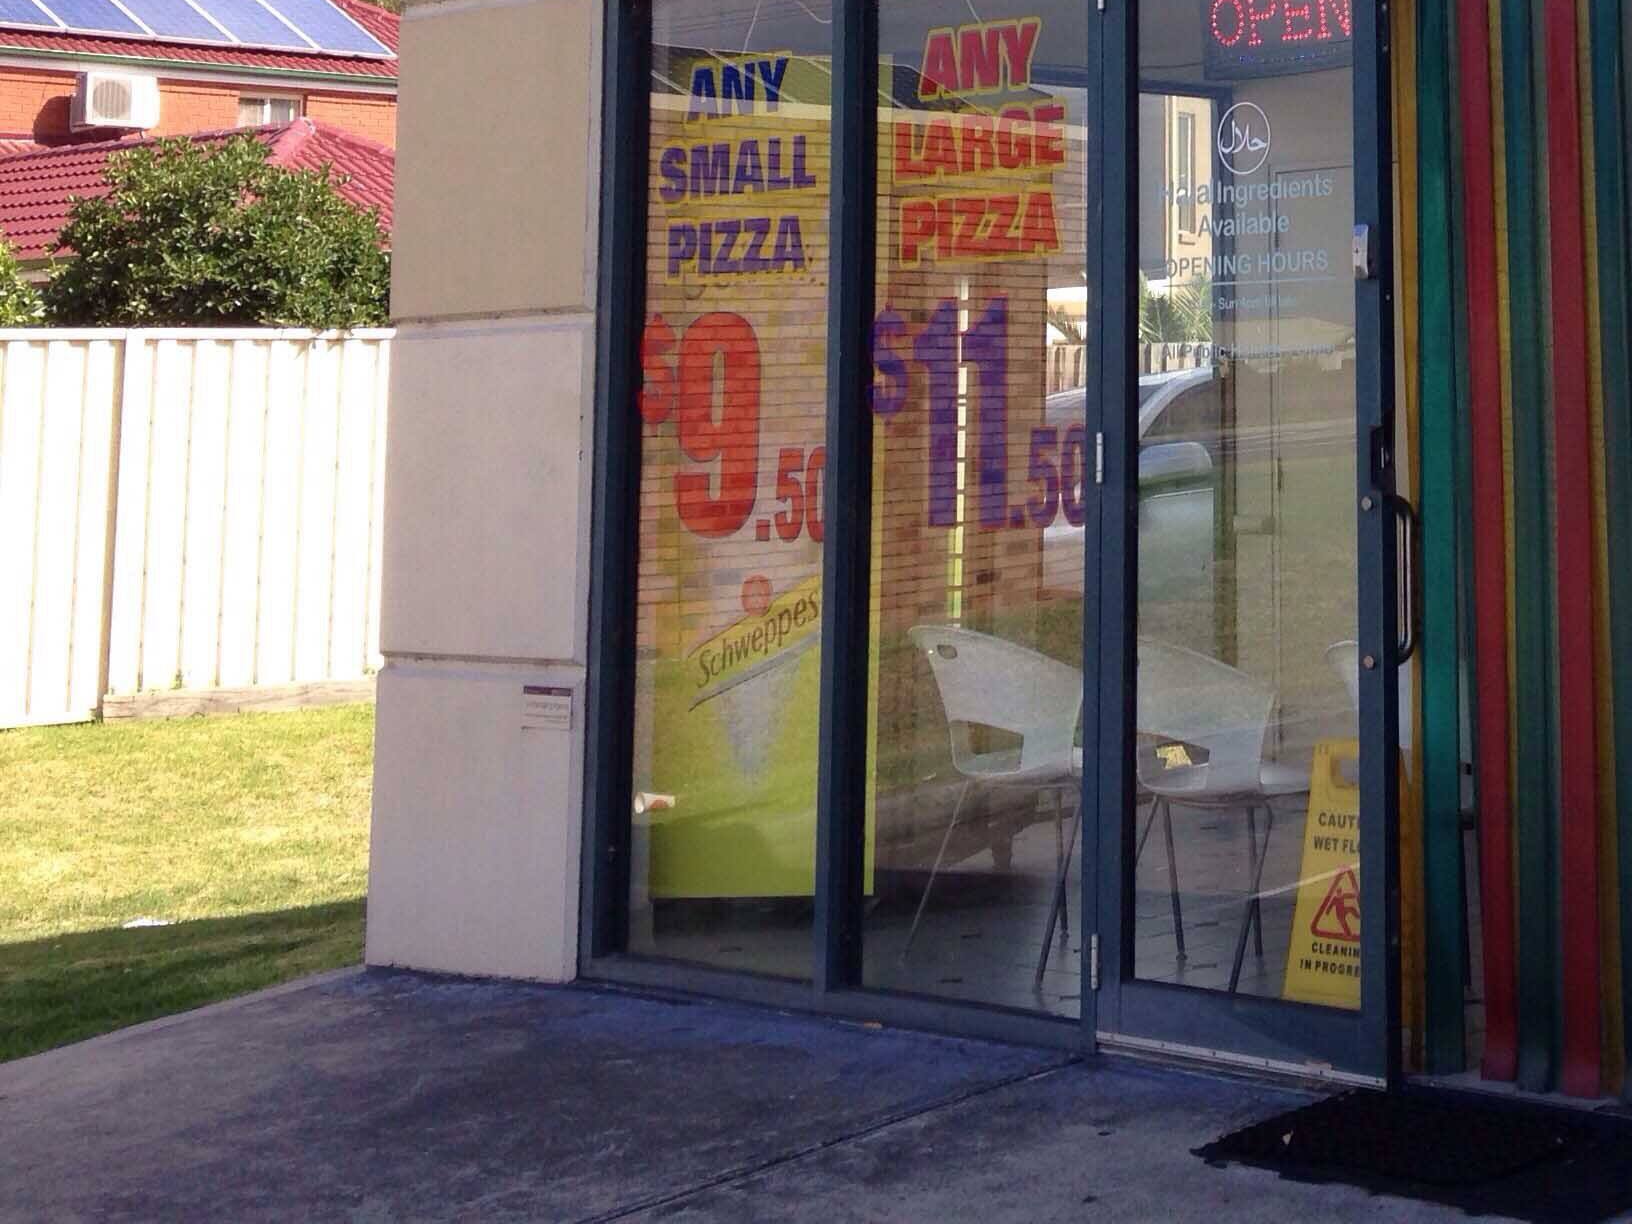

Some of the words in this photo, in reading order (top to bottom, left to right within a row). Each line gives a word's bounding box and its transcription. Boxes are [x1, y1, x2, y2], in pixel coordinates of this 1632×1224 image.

[919, 17, 1041, 100] ANY
[686, 51, 793, 124] ANY
[893, 96, 1068, 181] LARGE
[658, 133, 818, 206] SMALL
[1217, 172, 1334, 208] Ingredients
[667, 213, 808, 280] PIZZA
[901, 188, 1065, 265] PIZZA
[1197, 212, 1290, 238] Available
[1166, 254, 1251, 278] OPENING
[1258, 250, 1329, 274] HOURS
[696, 588, 819, 689] Schweppes
[1314, 836, 1339, 851] WET
[1343, 839, 1360, 853] FL
[1318, 812, 1360, 829] CAUT
[1300, 959, 1312, 969] IN
[1315, 960, 1360, 977] PROGRE
[1312, 942, 1360, 958] CLEANIN
